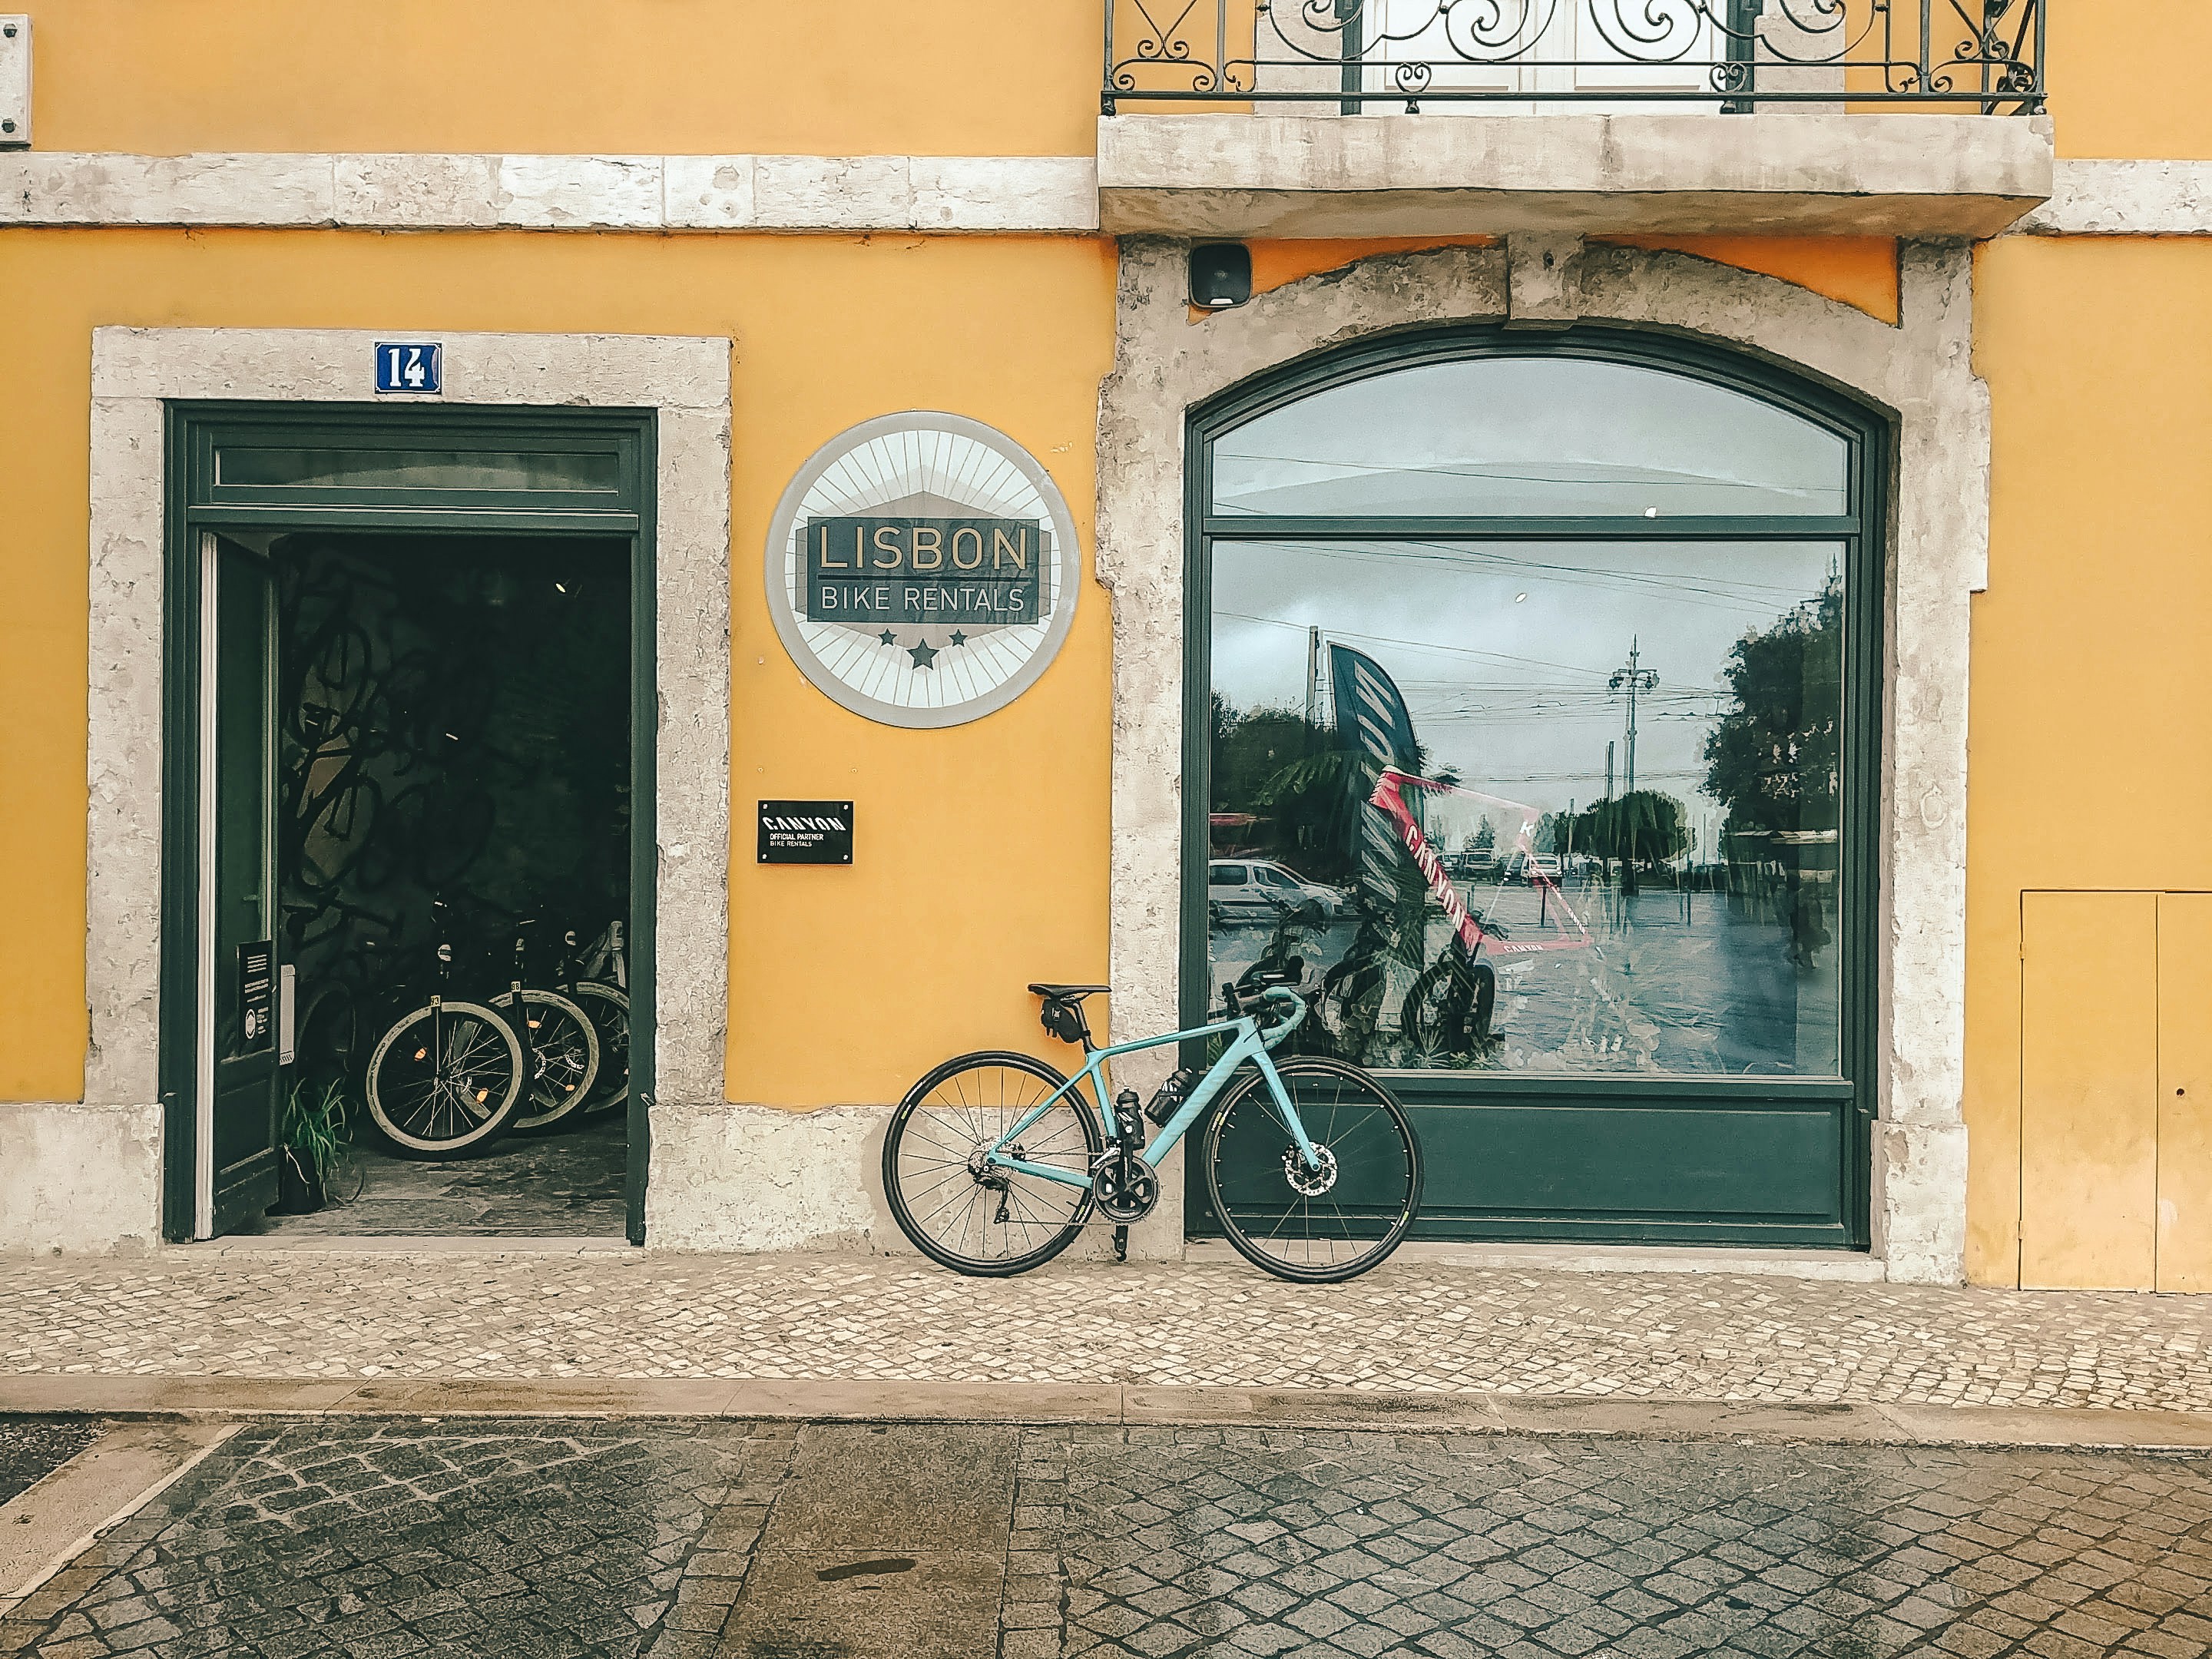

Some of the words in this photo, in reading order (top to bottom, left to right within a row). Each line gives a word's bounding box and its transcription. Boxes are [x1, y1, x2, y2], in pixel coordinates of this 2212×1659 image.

[388, 348, 426, 387] 14
[820, 525, 1027, 571] LISBON
[821, 586, 890, 611] BIKE
[904, 588, 1025, 612] RENTALS
[762, 816, 846, 831] CANYON
[796, 833, 824, 841] PARTNER
[1405, 824, 1465, 932] CANYON
[1503, 944, 1544, 953] CANYON
